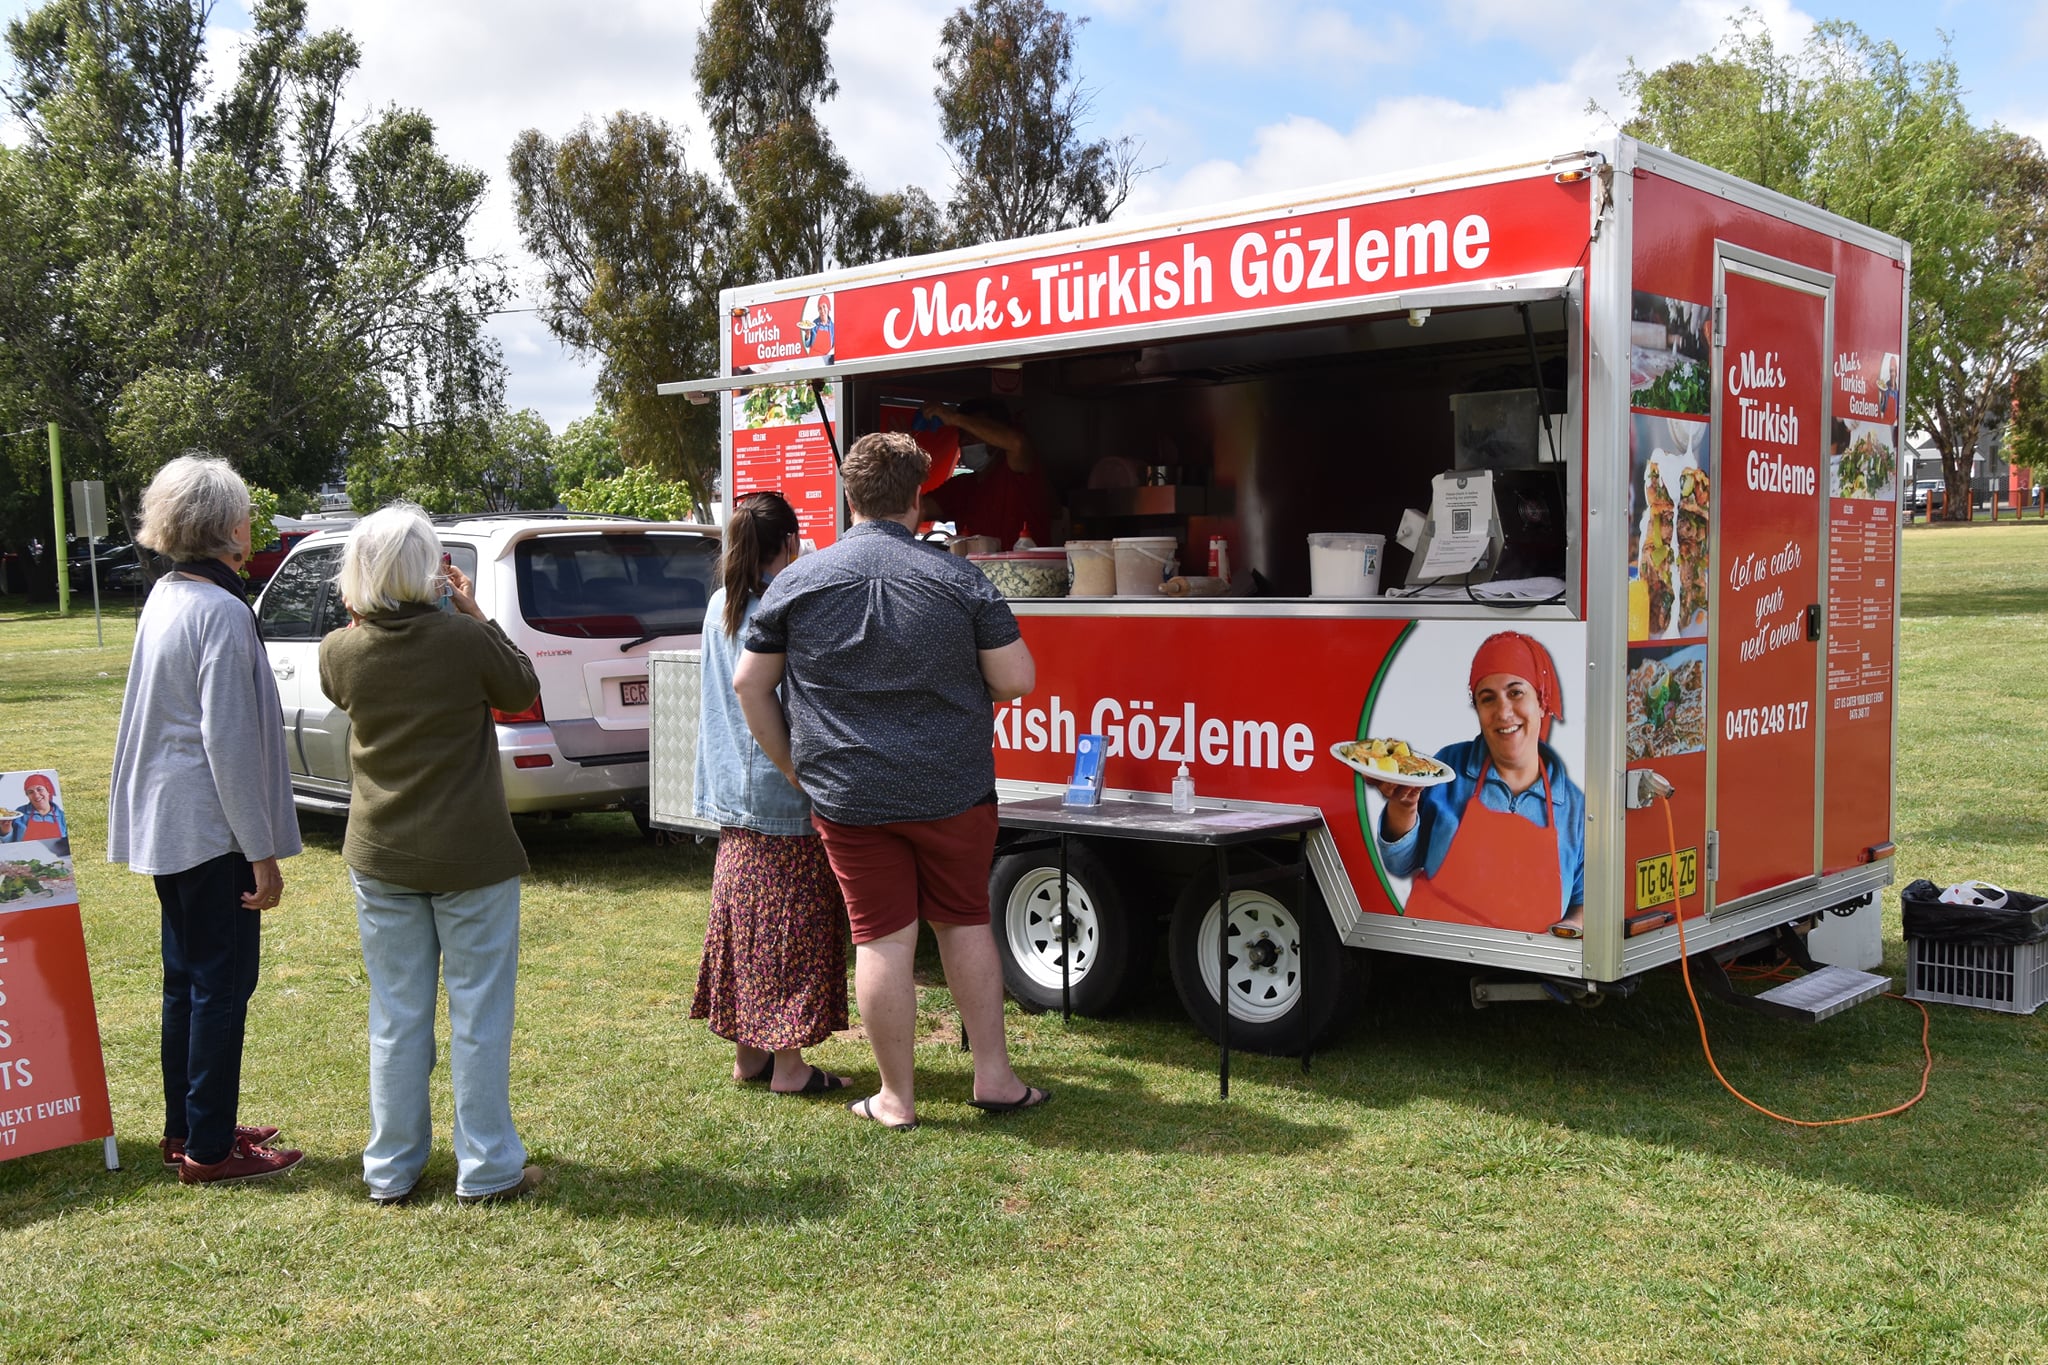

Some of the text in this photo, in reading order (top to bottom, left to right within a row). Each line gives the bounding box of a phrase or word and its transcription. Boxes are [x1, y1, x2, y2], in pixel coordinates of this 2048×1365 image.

[883, 214, 1490, 349] Mak's Türkish Gözleme
[734, 307, 773, 336] Mak's
[742, 324, 780, 345] Turkish
[757, 341, 802, 360] Gozleme
[1834, 352, 1861, 376] Mak's
[1729, 350, 1786, 396] Mak's
[1839, 373, 1866, 395] Turkish
[1738, 397, 1799, 446] Türkish
[1849, 395, 1879, 418] Gozleme
[1746, 449, 1815, 496] Gözleme
[1730, 552, 1755, 592] Let
[1754, 557, 1767, 582] us
[1770, 540, 1802, 576] cater
[1755, 586, 1784, 628] your
[1740, 622, 1770, 663] next
[1769, 609, 1804, 651] event
[992, 696, 1076, 754] kish
[1090, 697, 1315, 773] Gözleme
[1726, 701, 1809, 741] 0476 248 717
[37, 1096, 81, 1120] EVENT
